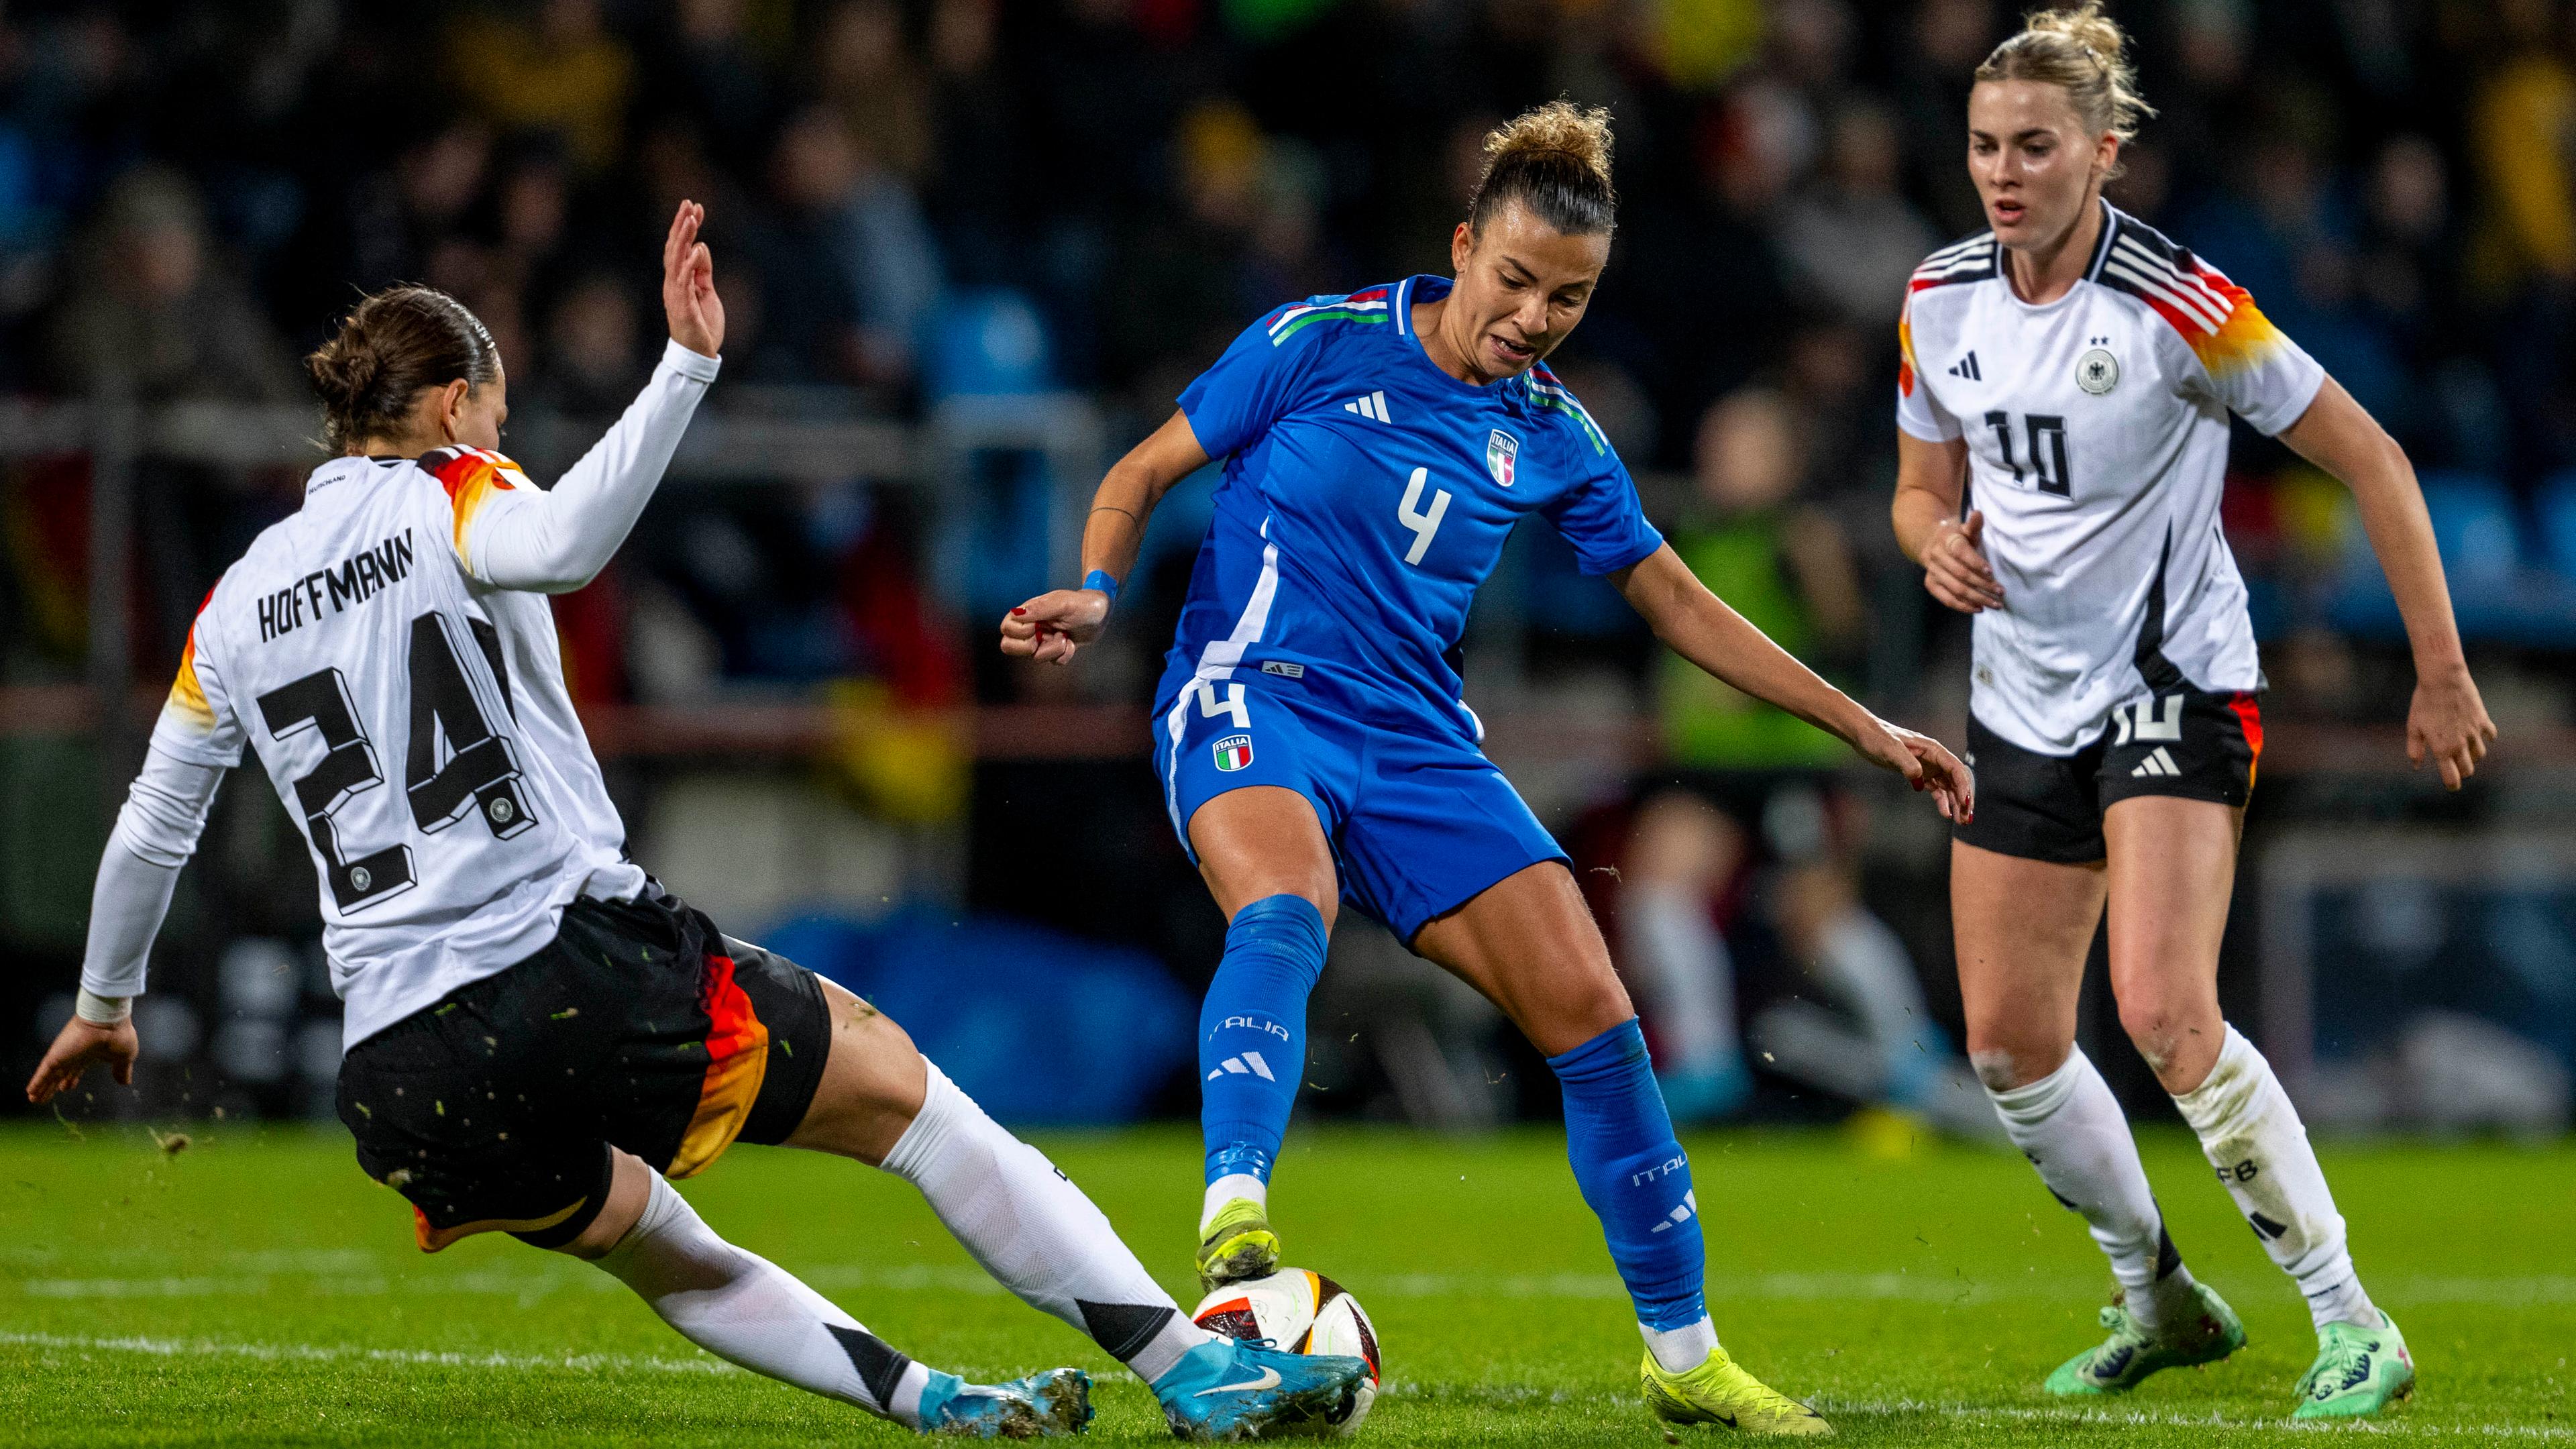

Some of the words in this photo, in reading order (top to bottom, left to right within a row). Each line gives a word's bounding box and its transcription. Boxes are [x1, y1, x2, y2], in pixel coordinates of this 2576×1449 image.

[1491, 433, 1514, 454] ITALIA
[1984, 410, 2076, 502] 10
[1397, 467, 1452, 566] 4
[258, 527, 413, 643] HOFFMANN
[1197, 683, 1251, 728] 4
[256, 611, 539, 915] 24
[1216, 737, 1248, 751] ITALIA
[1209, 1016, 1289, 1041] ITALIA
